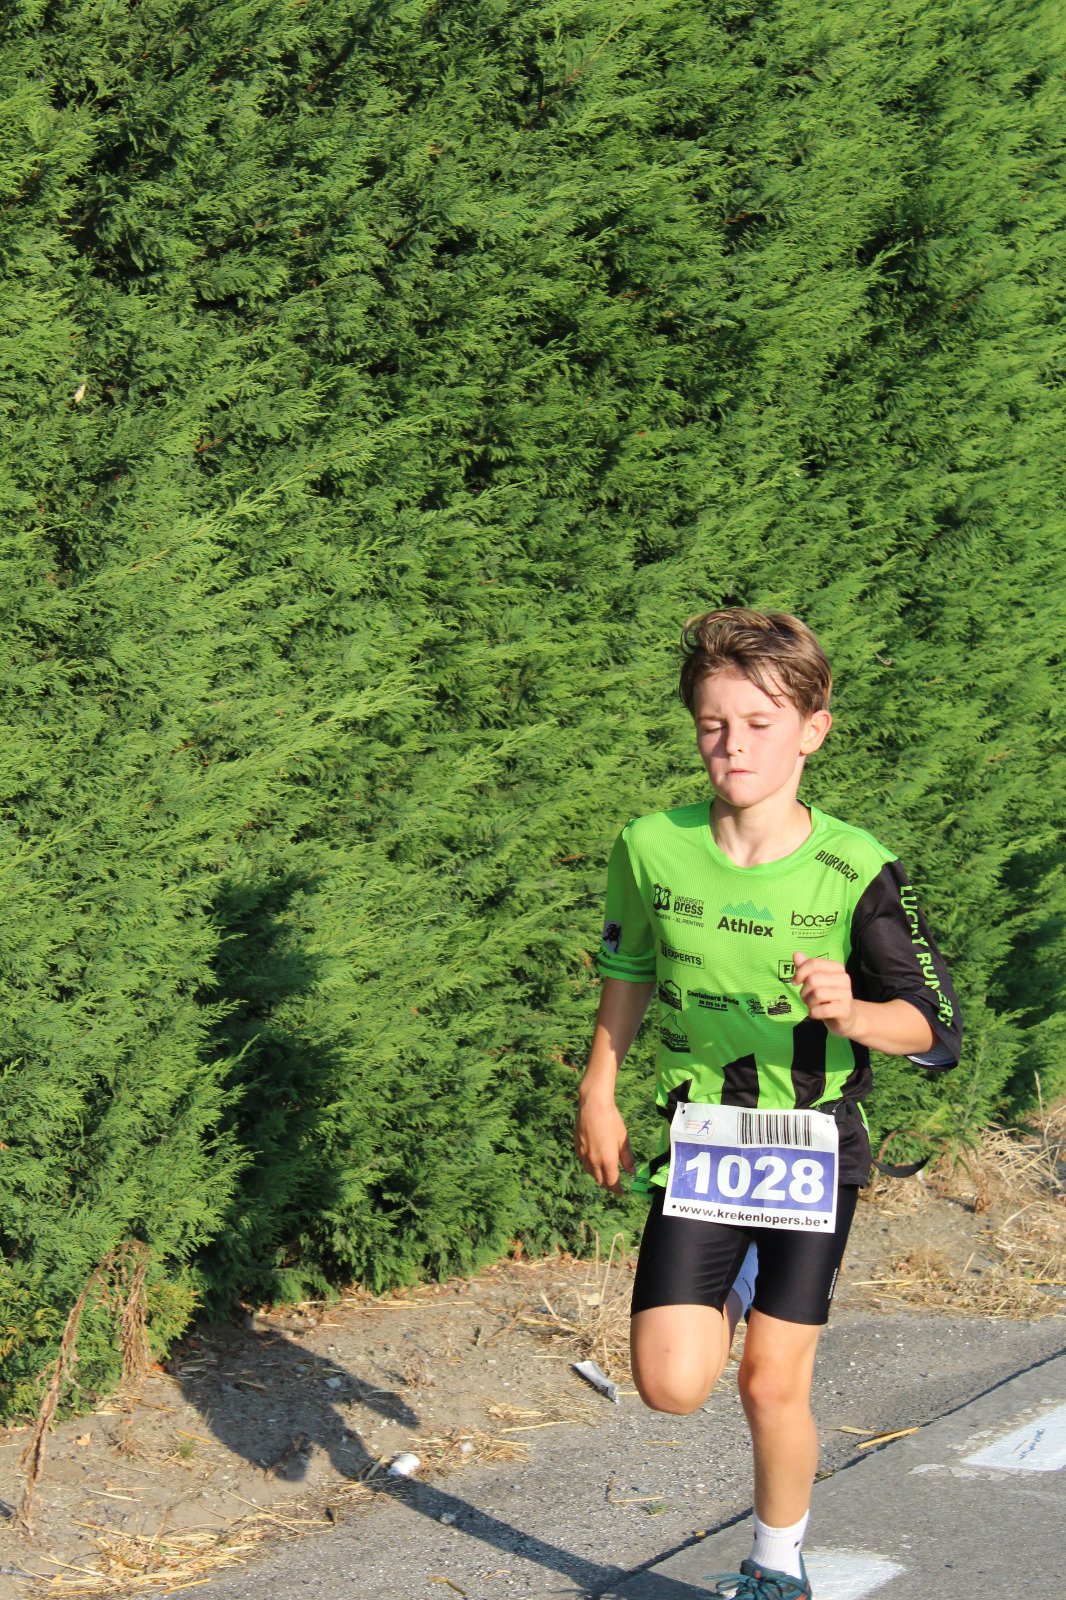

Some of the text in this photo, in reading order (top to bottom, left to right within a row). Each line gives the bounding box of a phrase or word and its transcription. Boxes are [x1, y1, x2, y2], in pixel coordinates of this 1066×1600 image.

[814, 849, 859, 882] BIORACER
[674, 900, 704, 915] press
[716, 916, 774, 938] Athlex
[687, 989, 722, 1002] Containers
[916, 952, 954, 1026] RUNERS
[685, 1151, 825, 1204] 1028
[679, 1204, 821, 1226] www.krekenlopers.be
